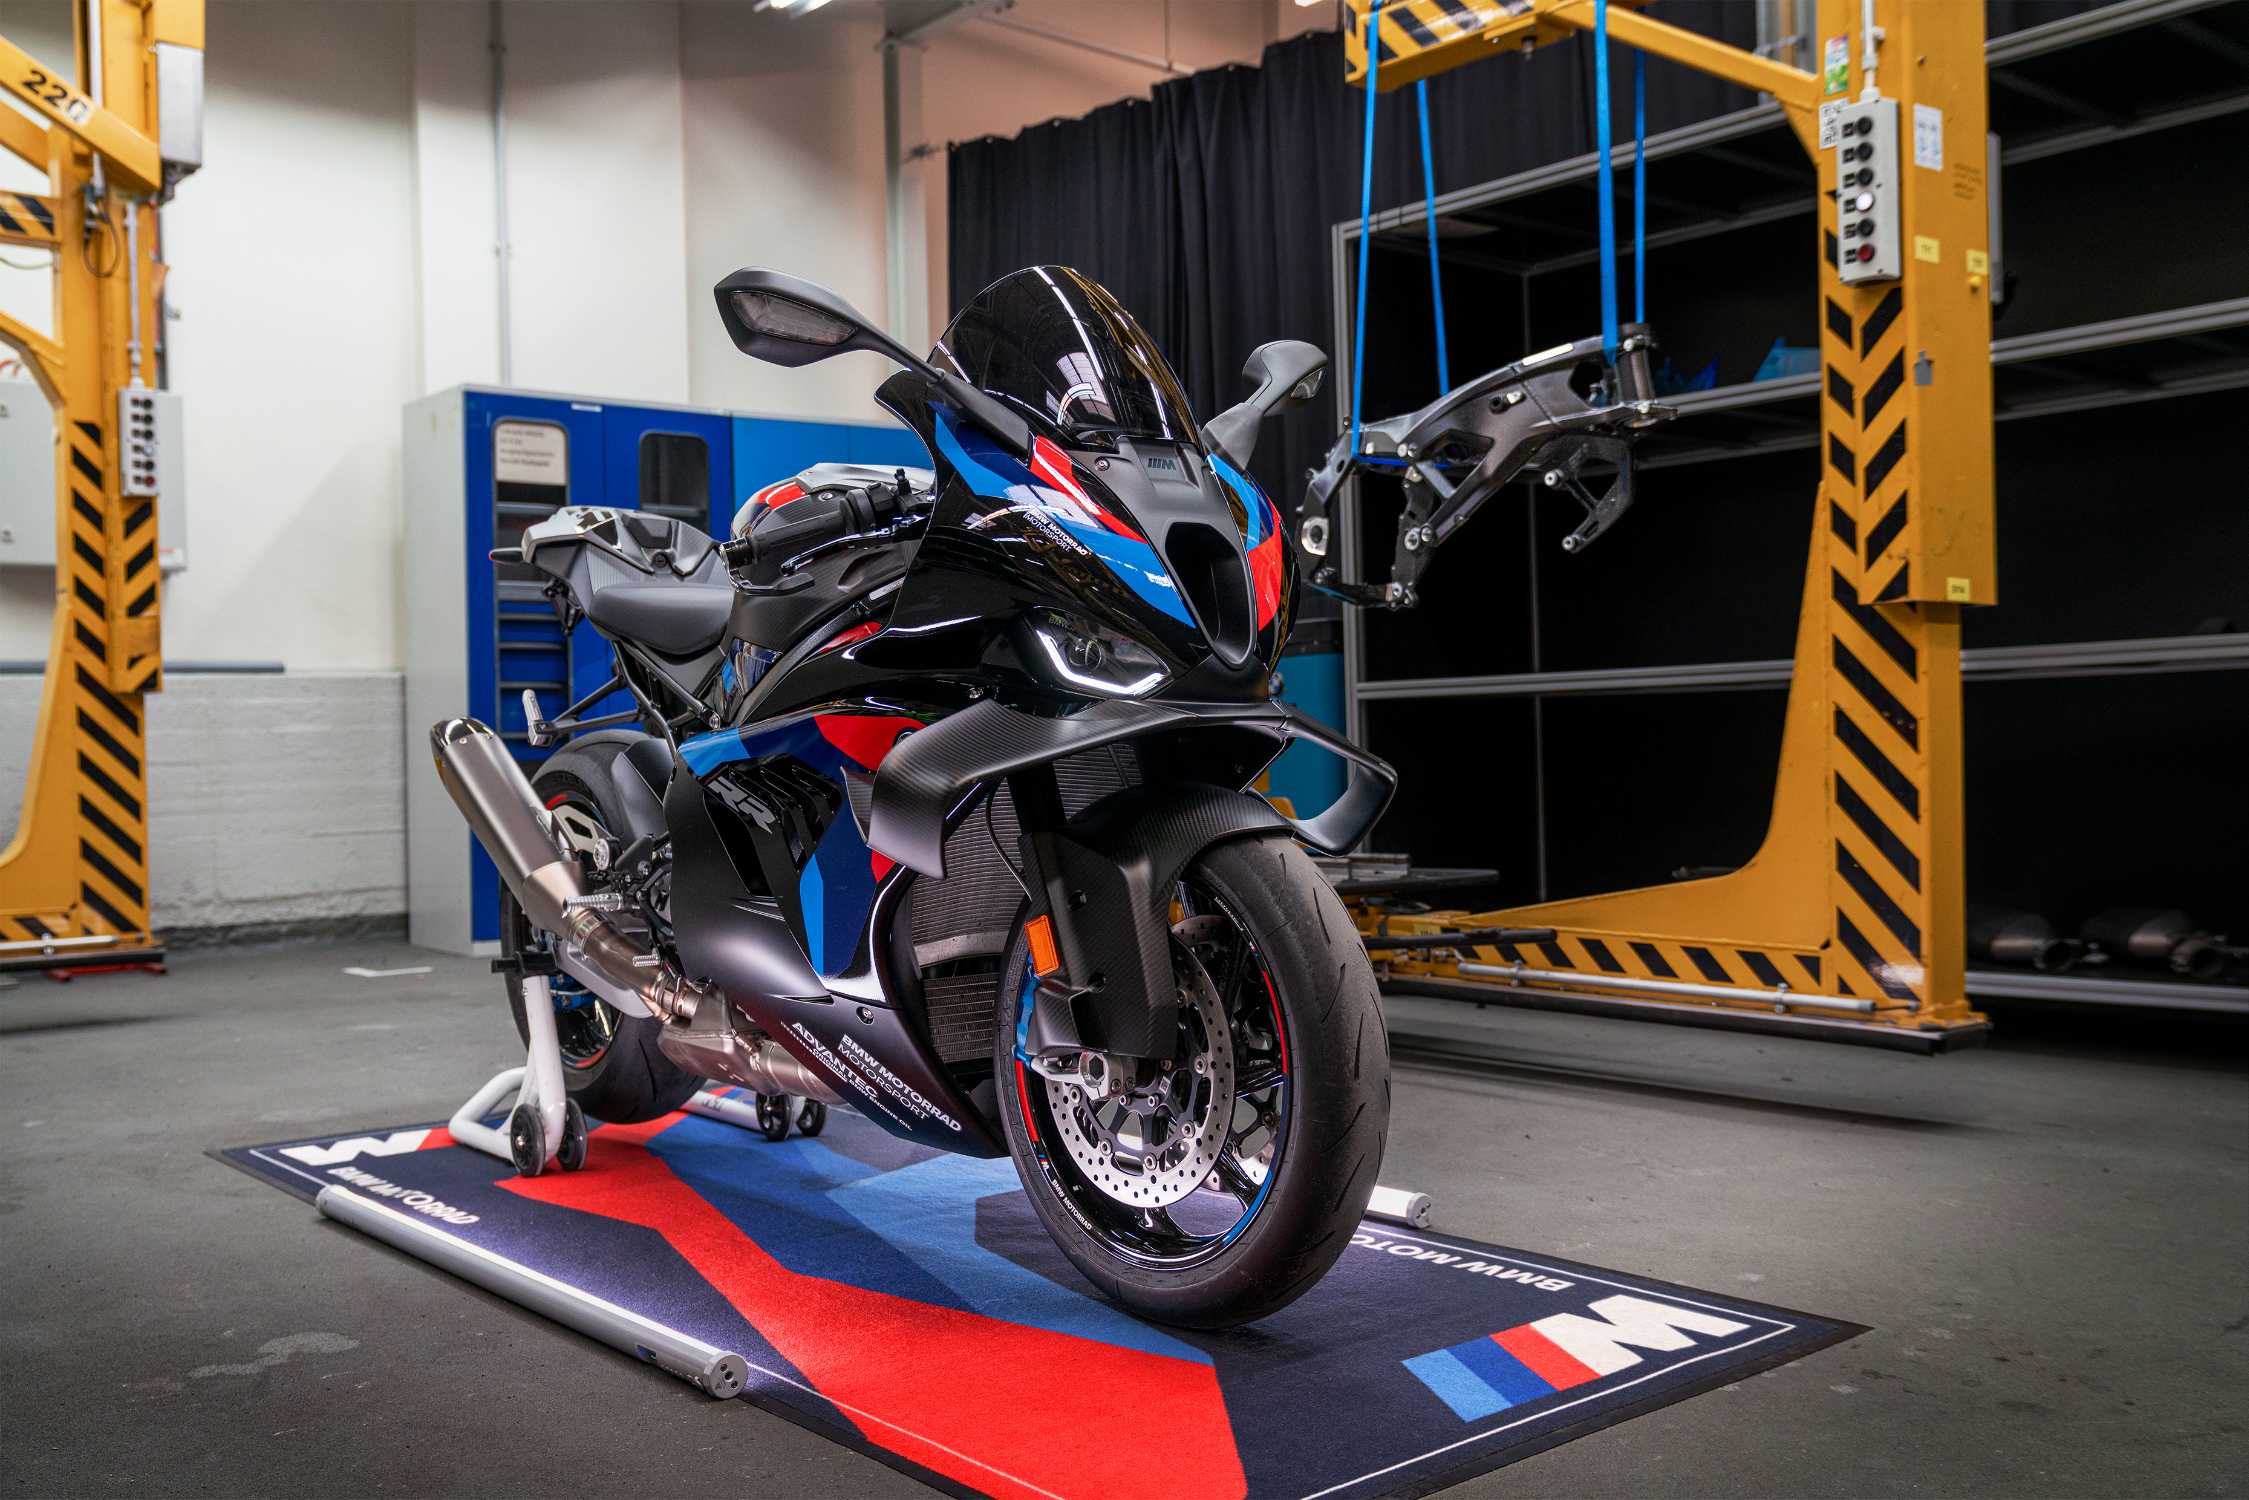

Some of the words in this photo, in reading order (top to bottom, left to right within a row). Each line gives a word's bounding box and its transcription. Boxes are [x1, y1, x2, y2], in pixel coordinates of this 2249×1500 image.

[1023, 511, 1071, 551] MOTORSPORT
[1048, 522, 1088, 556] MOTORRAD
[707, 776, 776, 834] RR
[792, 1022, 878, 1098] ADVANTEC
[837, 1044, 930, 1119] MOTORSPORT
[842, 1034, 880, 1067] BMW
[878, 1066, 962, 1132] MOTORRAD
[899, 1119, 913, 1131] OIL
[1051, 1179, 1066, 1198] BMW
[1063, 1197, 1092, 1230] MOTORRAD
[1350, 1234, 1462, 1265] MOTO
[1452, 1261, 1577, 1292] BMW
